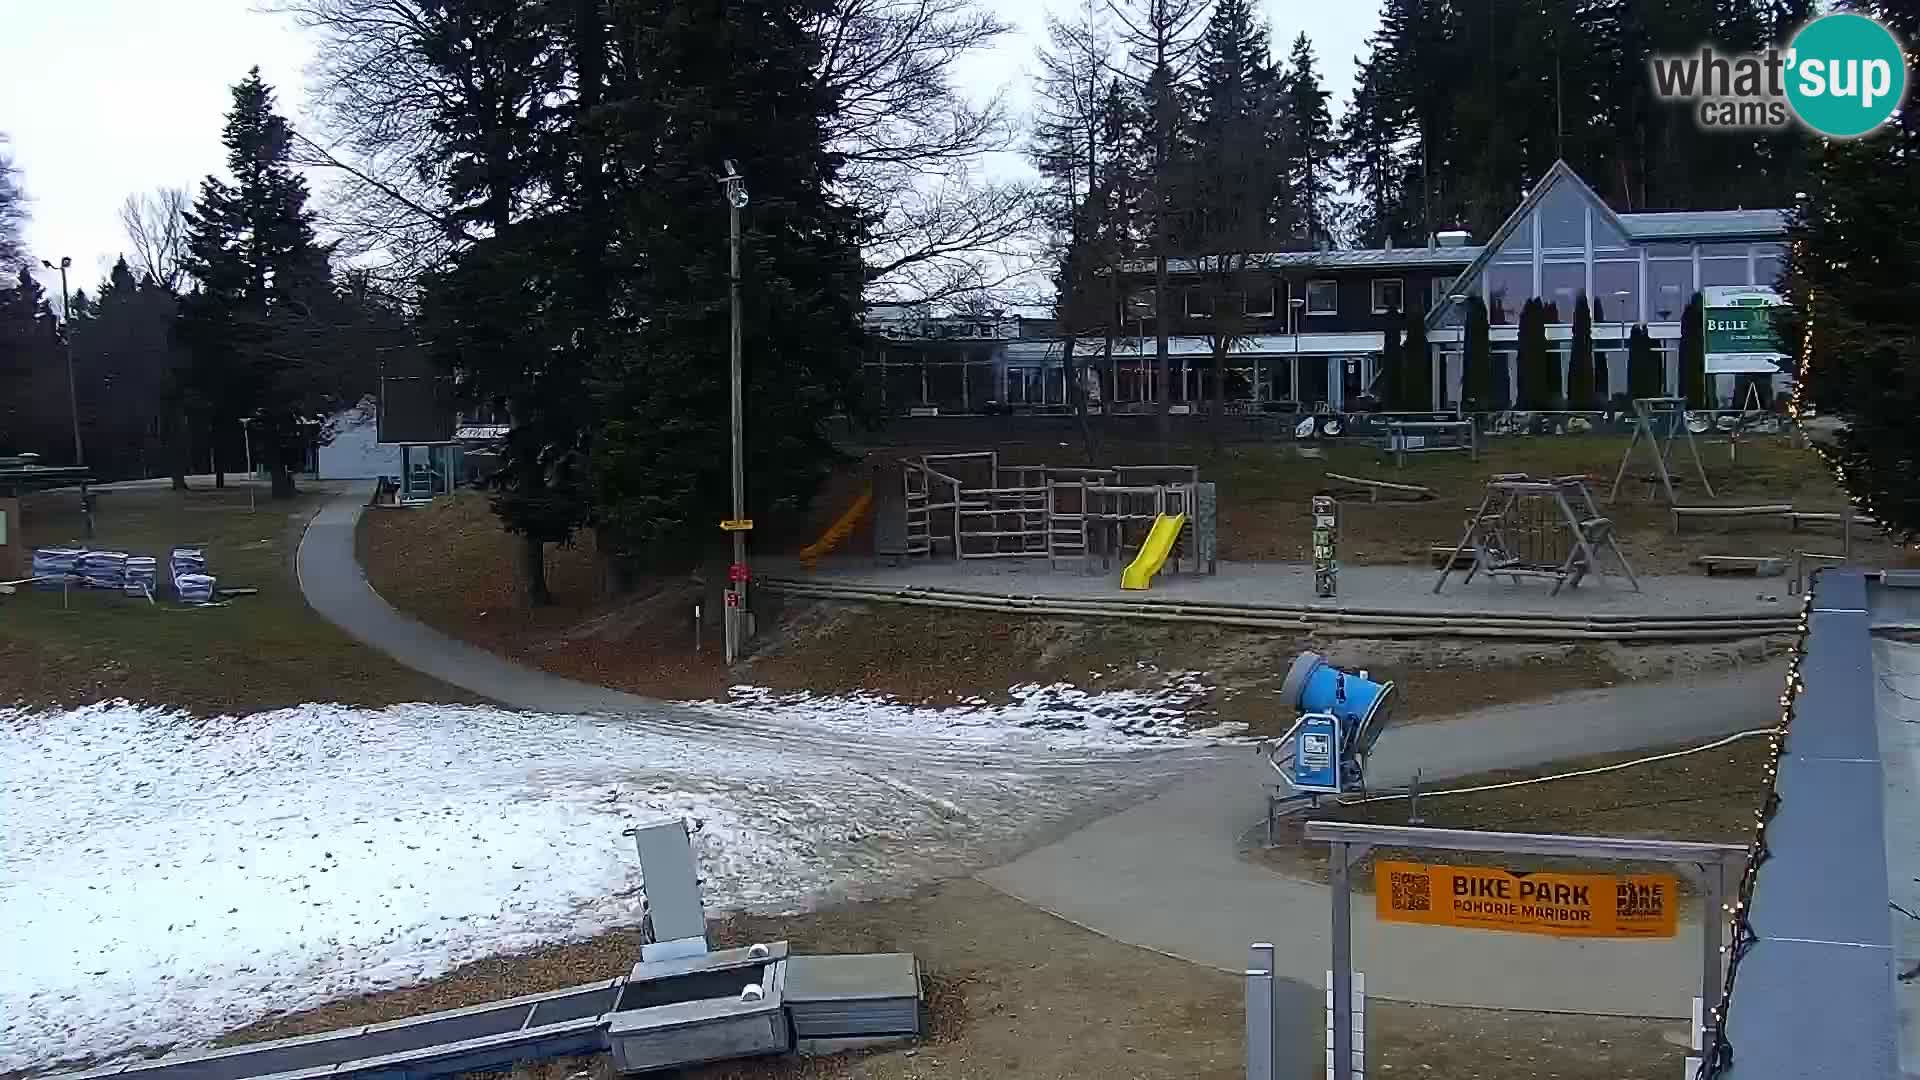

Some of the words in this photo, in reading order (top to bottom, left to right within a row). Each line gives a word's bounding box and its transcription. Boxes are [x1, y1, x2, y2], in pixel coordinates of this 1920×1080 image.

[1707, 319, 1748, 331] BELLE
[1453, 874, 1511, 899] BIKE
[1520, 881, 1590, 905] PARK
[1522, 906, 1592, 921] MARIBOR
